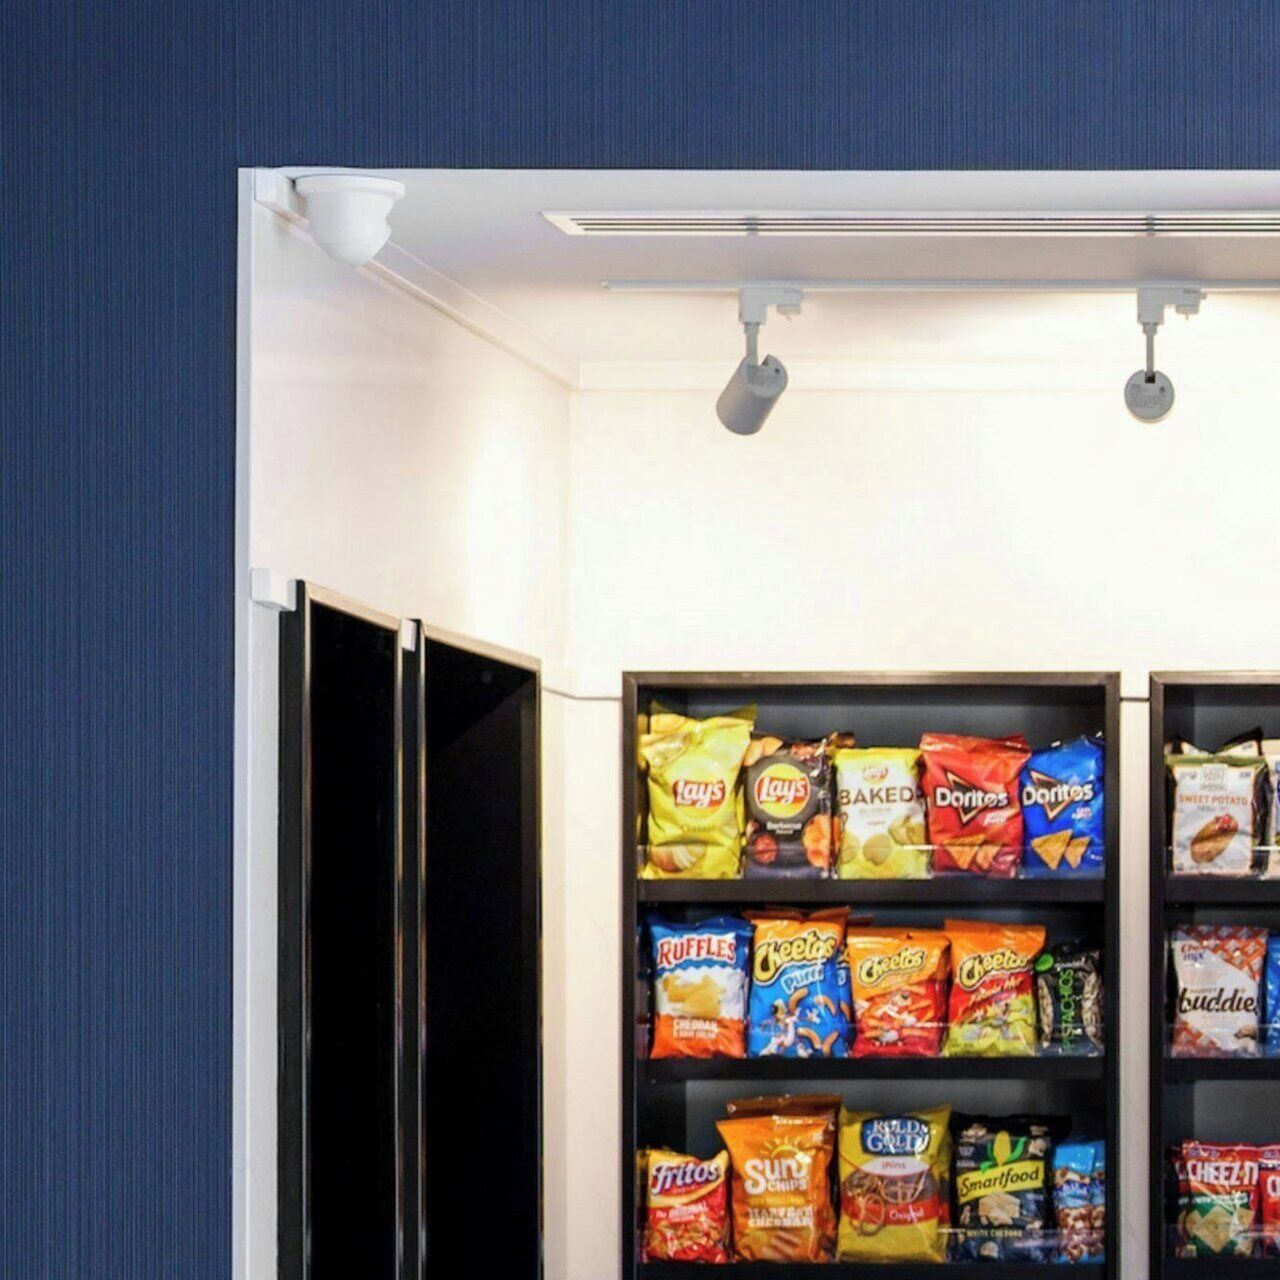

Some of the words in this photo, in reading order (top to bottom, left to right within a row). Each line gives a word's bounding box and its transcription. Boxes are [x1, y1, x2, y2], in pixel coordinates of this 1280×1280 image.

[839, 787, 915, 806] BAKED
[935, 787, 1009, 808] Doritos
[1022, 783, 1095, 806] Doritos
[657, 936, 737, 968] RUFFLES
[754, 930, 837, 983] Cheetos
[858, 949, 926, 984] Cheetos
[959, 950, 1028, 989] Cheetos
[872, 1118, 920, 1134] ROLD
[866, 1132, 922, 1153] GOLD
[766, 1179, 808, 1192] CHIPS
[959, 1169, 1041, 1198] Smartfood
